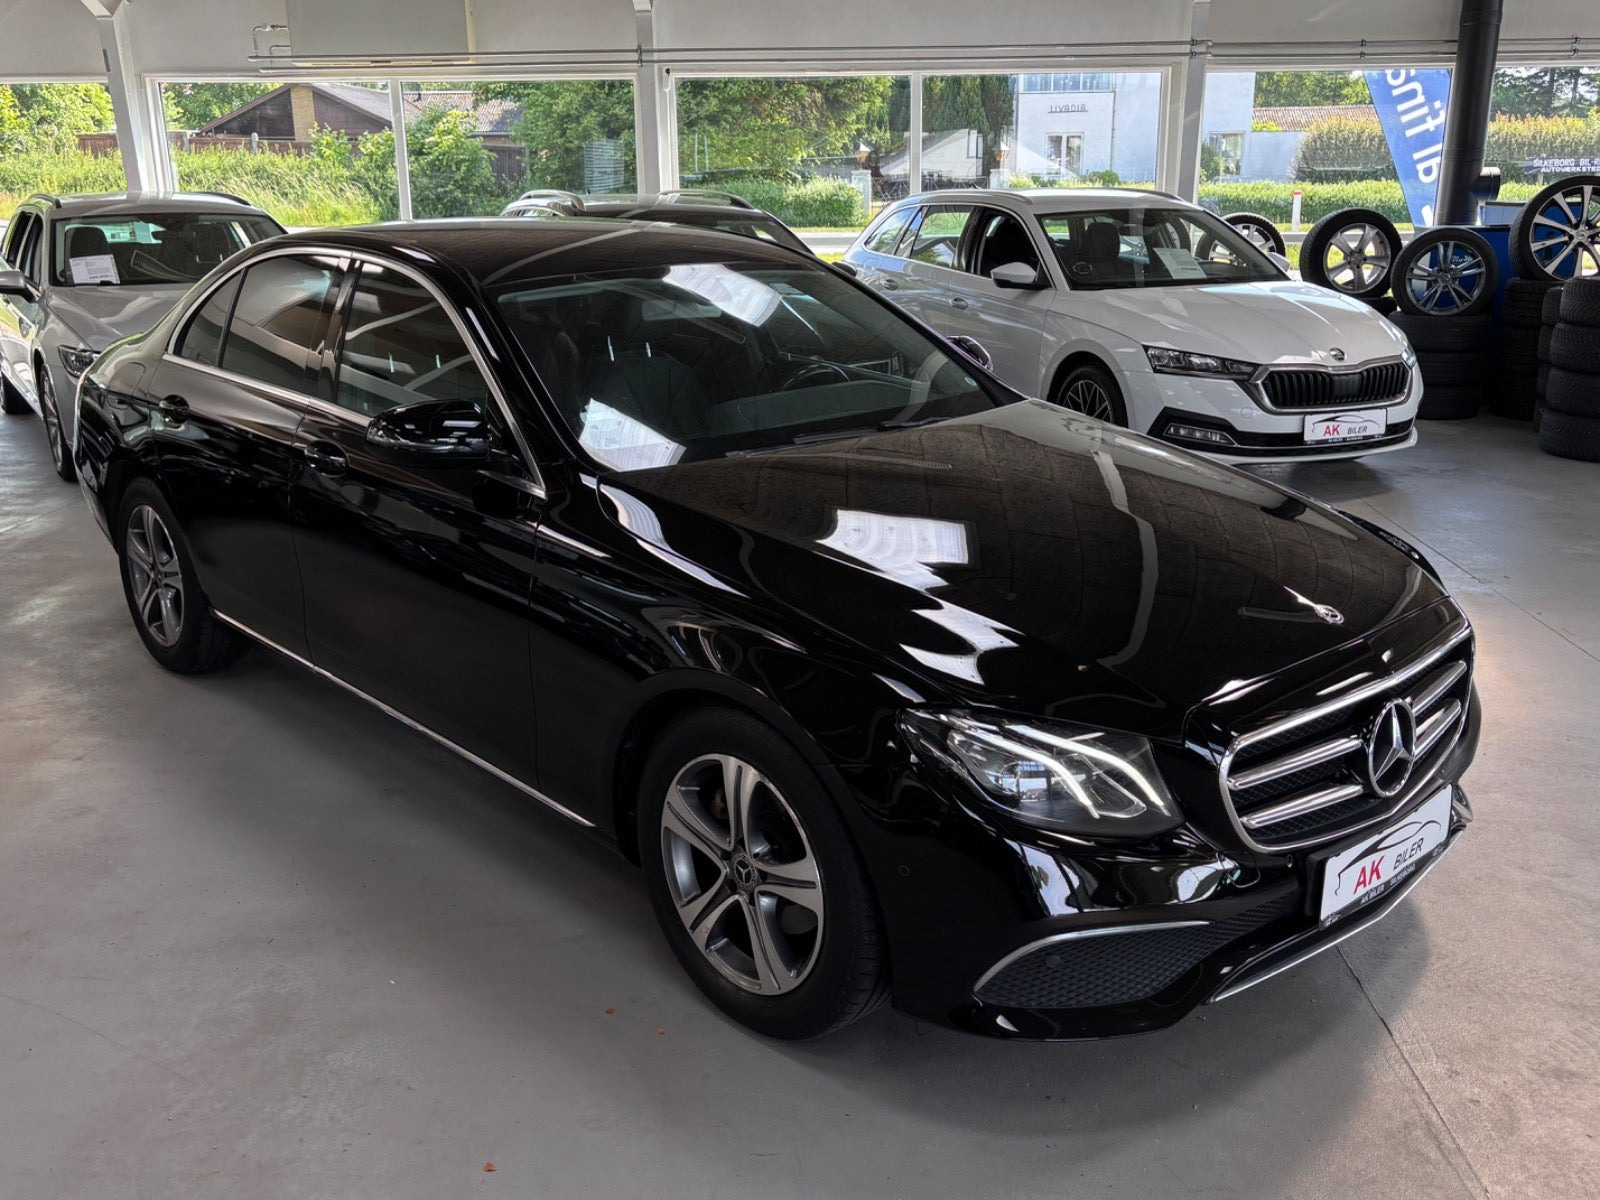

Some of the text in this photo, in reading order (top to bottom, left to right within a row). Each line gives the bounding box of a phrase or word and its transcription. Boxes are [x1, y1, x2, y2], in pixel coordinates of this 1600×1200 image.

[1533, 158, 1575, 167] SILKEBORG
[1323, 424, 1368, 437] AK BILER
[1353, 837, 1424, 896] AK BILER
